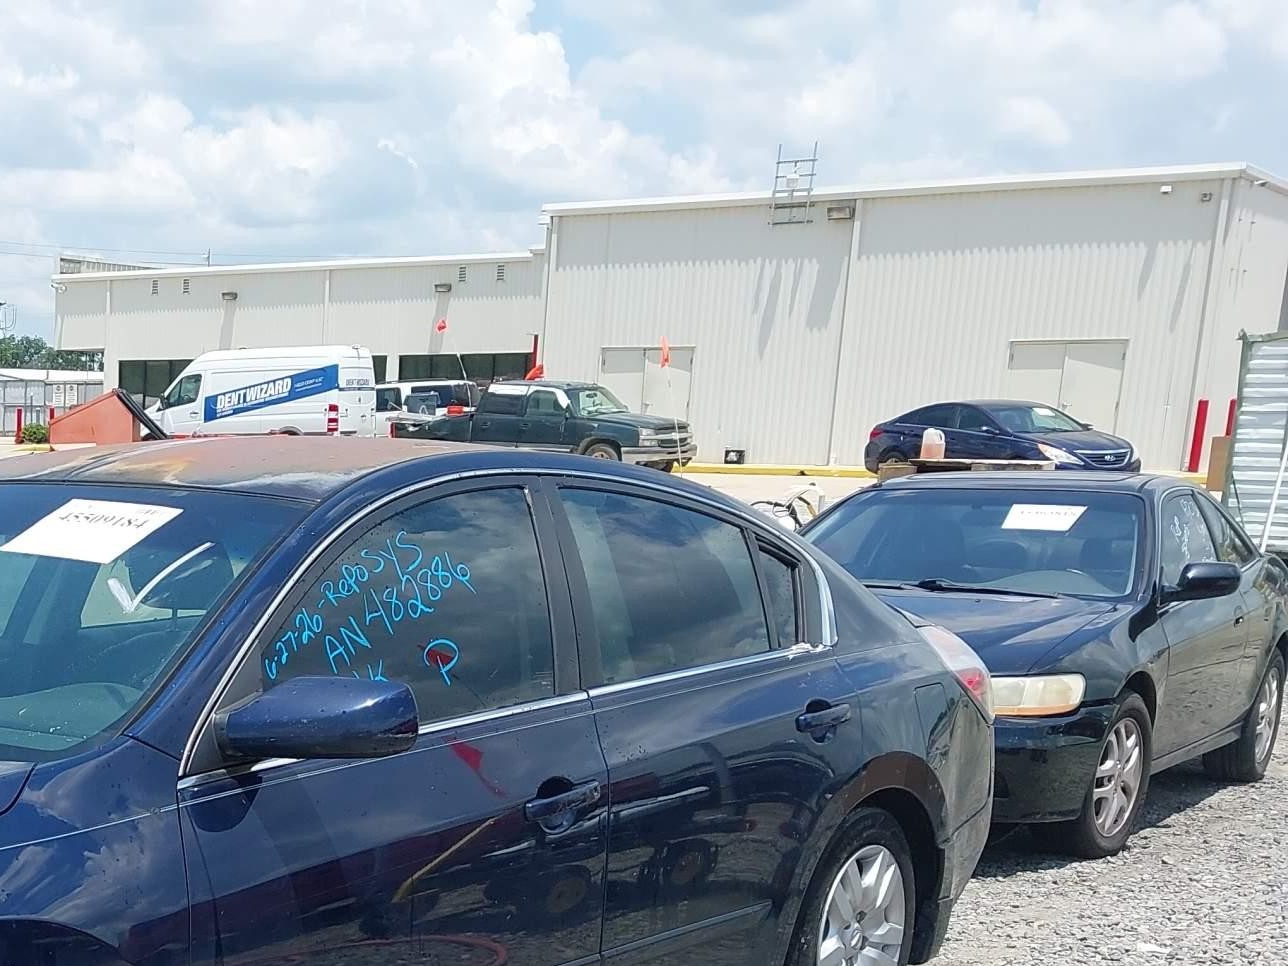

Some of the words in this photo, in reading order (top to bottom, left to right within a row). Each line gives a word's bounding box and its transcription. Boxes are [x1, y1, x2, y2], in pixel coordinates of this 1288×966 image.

[216, 389, 247, 410] DENT
[245, 377, 293, 403] WIZARD
[423, 638, 460, 687] P
